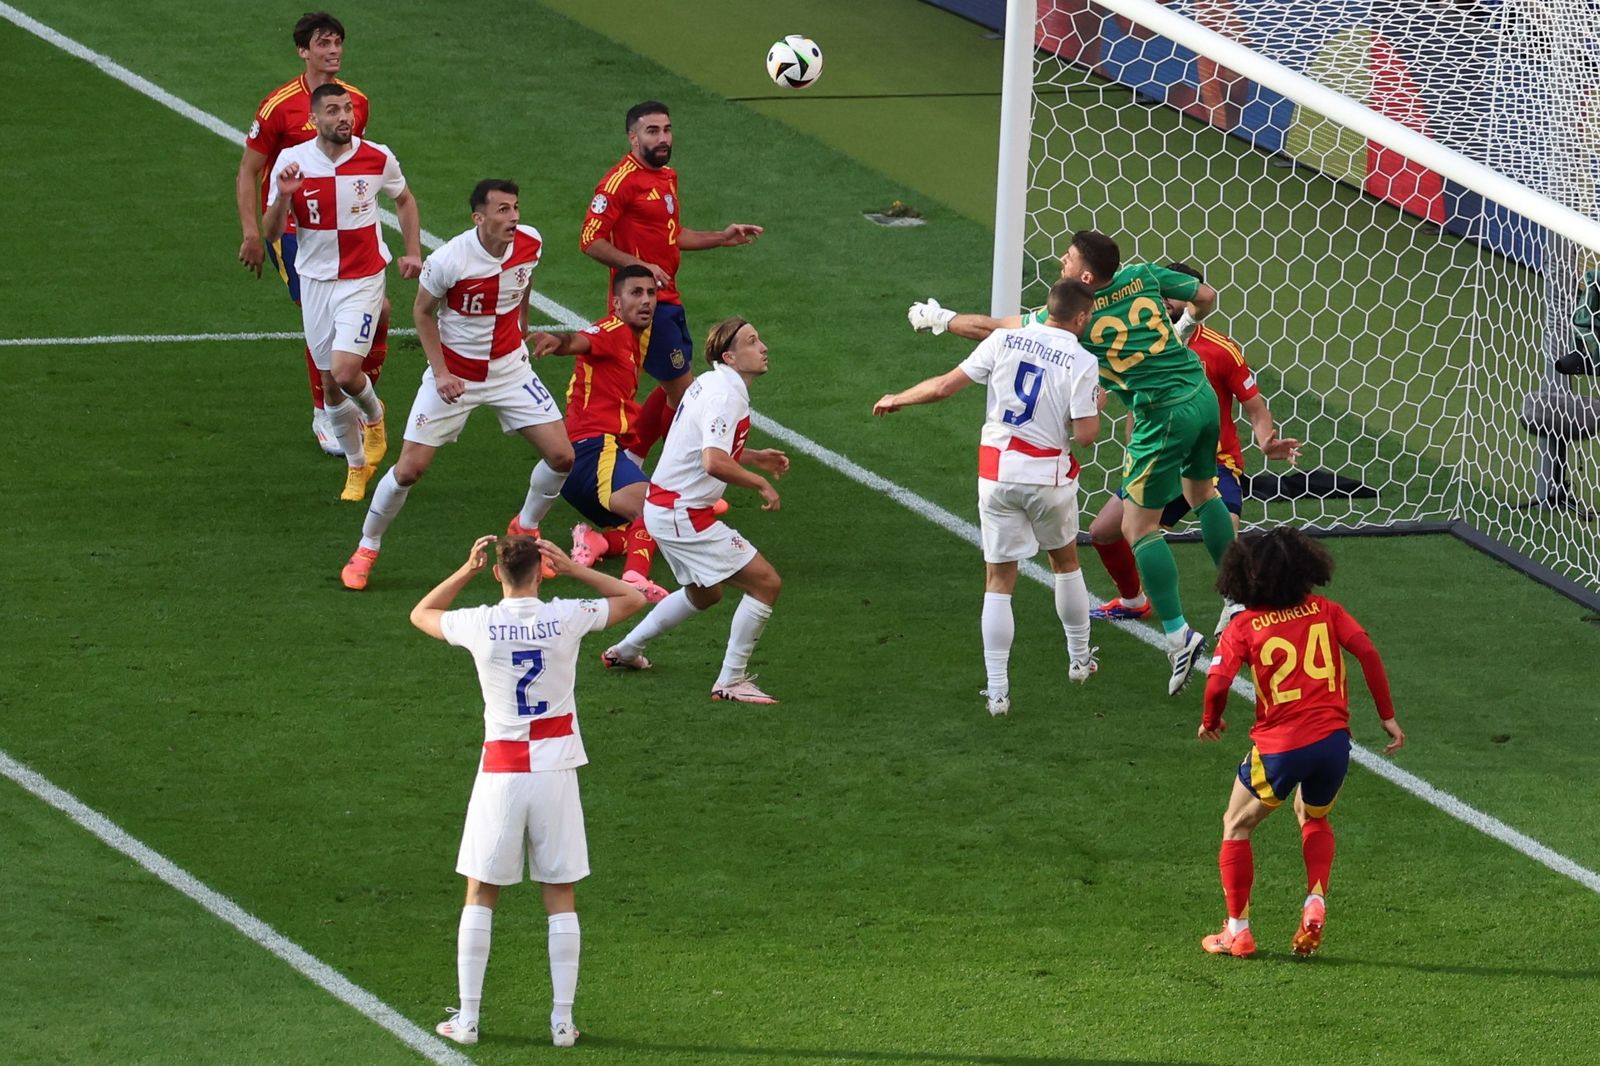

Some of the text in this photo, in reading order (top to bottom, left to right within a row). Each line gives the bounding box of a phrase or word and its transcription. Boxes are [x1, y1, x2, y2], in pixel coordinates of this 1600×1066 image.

[306, 199, 320, 224] 8
[667, 218, 676, 246] 2
[460, 292, 485, 314] 16
[359, 312, 373, 340] 8
[1090, 296, 1169, 373] 23
[522, 377, 550, 405] 16
[1002, 360, 1046, 428] 9
[1251, 601, 1321, 632] CUCURELLA
[1259, 622, 1336, 706] 24
[511, 649, 549, 717] 2
